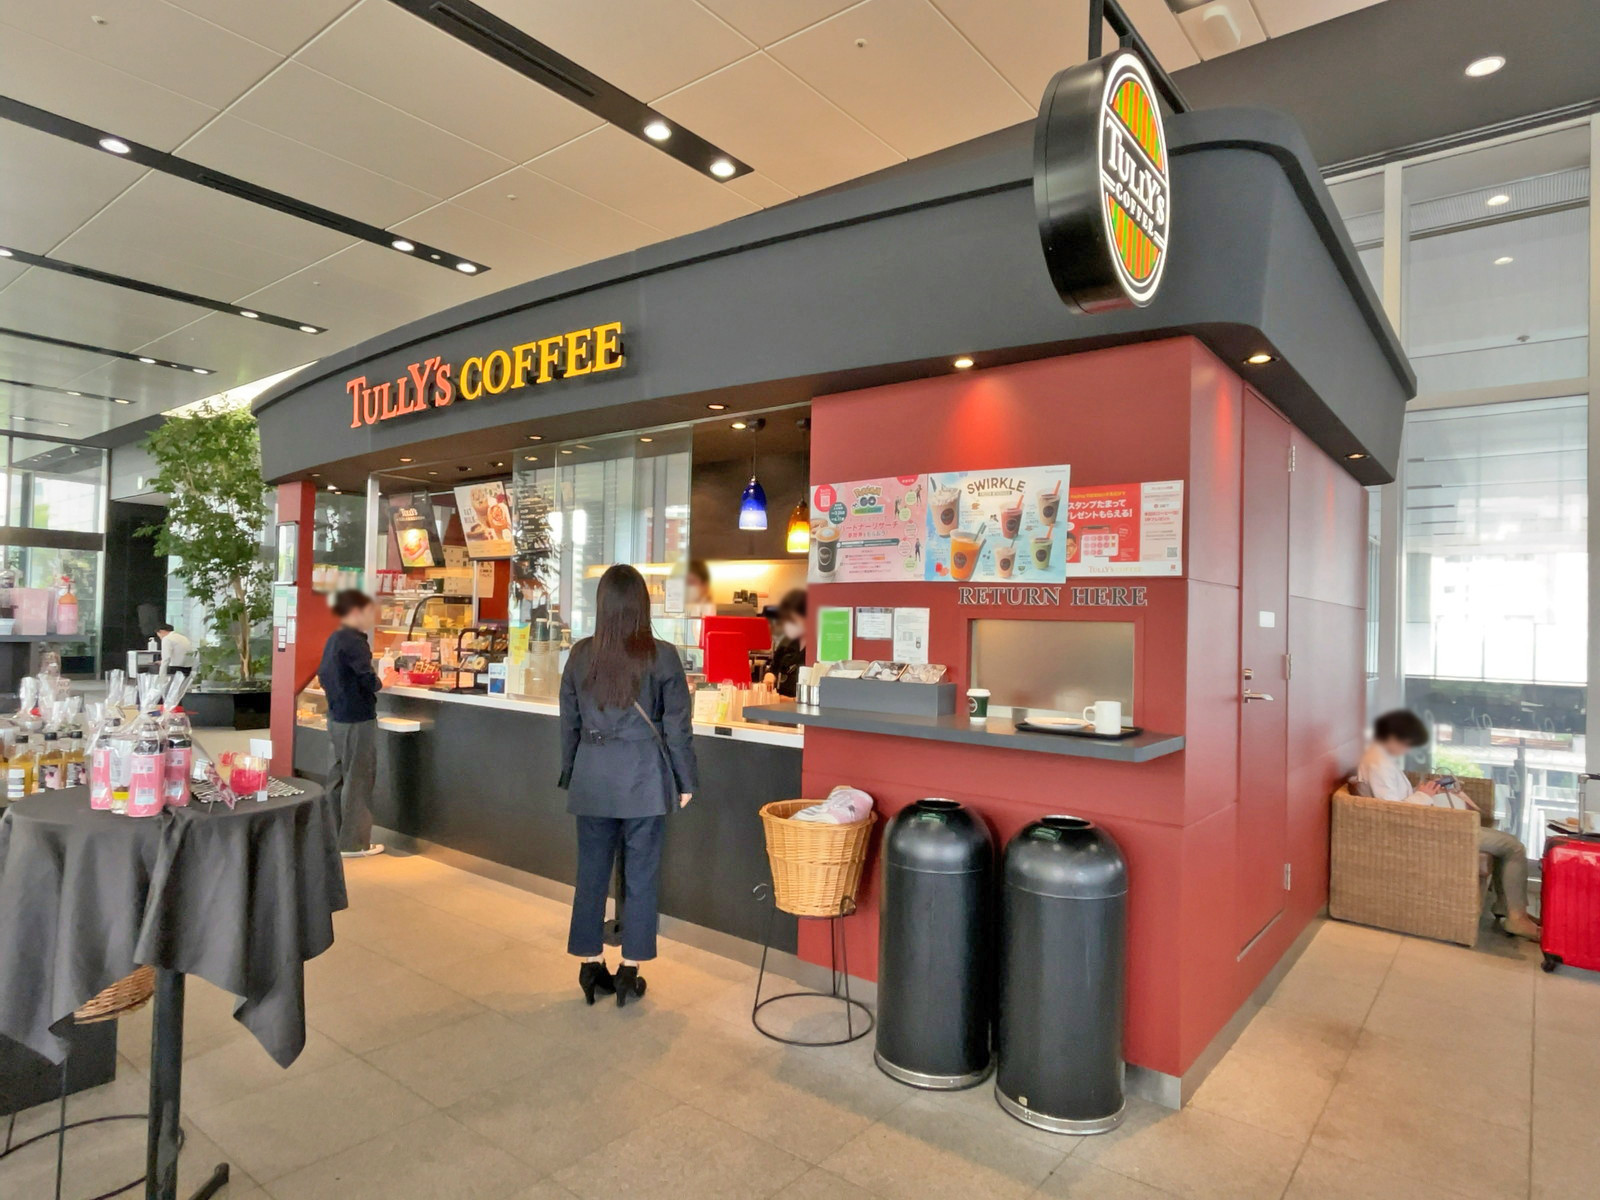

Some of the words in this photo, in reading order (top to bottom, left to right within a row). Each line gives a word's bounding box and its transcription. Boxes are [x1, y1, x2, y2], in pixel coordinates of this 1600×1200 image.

[1105, 117, 1166, 226] TULLY'S
[1114, 183, 1155, 237] COFFEE
[347, 356, 452, 428] TULLY'S
[460, 321, 623, 401] COFFEE
[967, 477, 1026, 495] SWIRKLE
[1068, 499, 1127, 510] スタンプたまって
[1068, 509, 1133, 520] レゼントもらえる!
[958, 586, 1060, 606] RETURN
[1071, 586, 1148, 607] HERE
